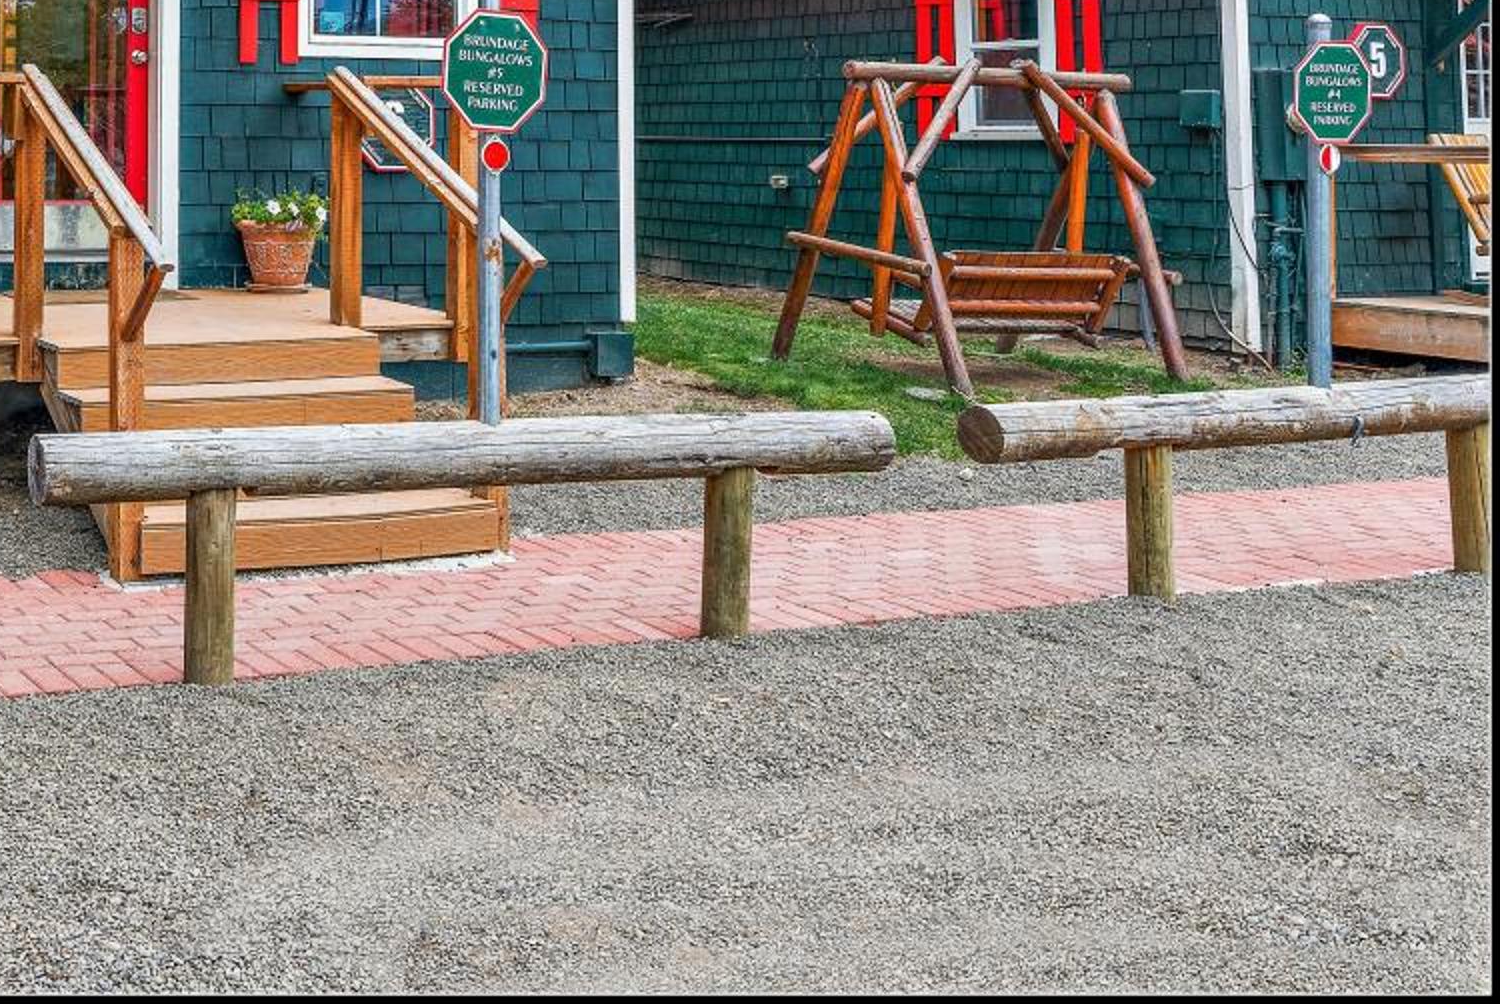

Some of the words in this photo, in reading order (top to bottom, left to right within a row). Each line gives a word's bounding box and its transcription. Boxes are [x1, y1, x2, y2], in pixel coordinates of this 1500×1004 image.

[464, 35, 529, 51] BRUNDAGE
[459, 49, 533, 67] BUNGALOWS
[1370, 42, 1387, 79] 5
[487, 67, 504, 79] #5
[463, 80, 524, 96] RESERVED
[467, 97, 518, 112] PARKING
[1310, 102, 1356, 113] RESERVED
